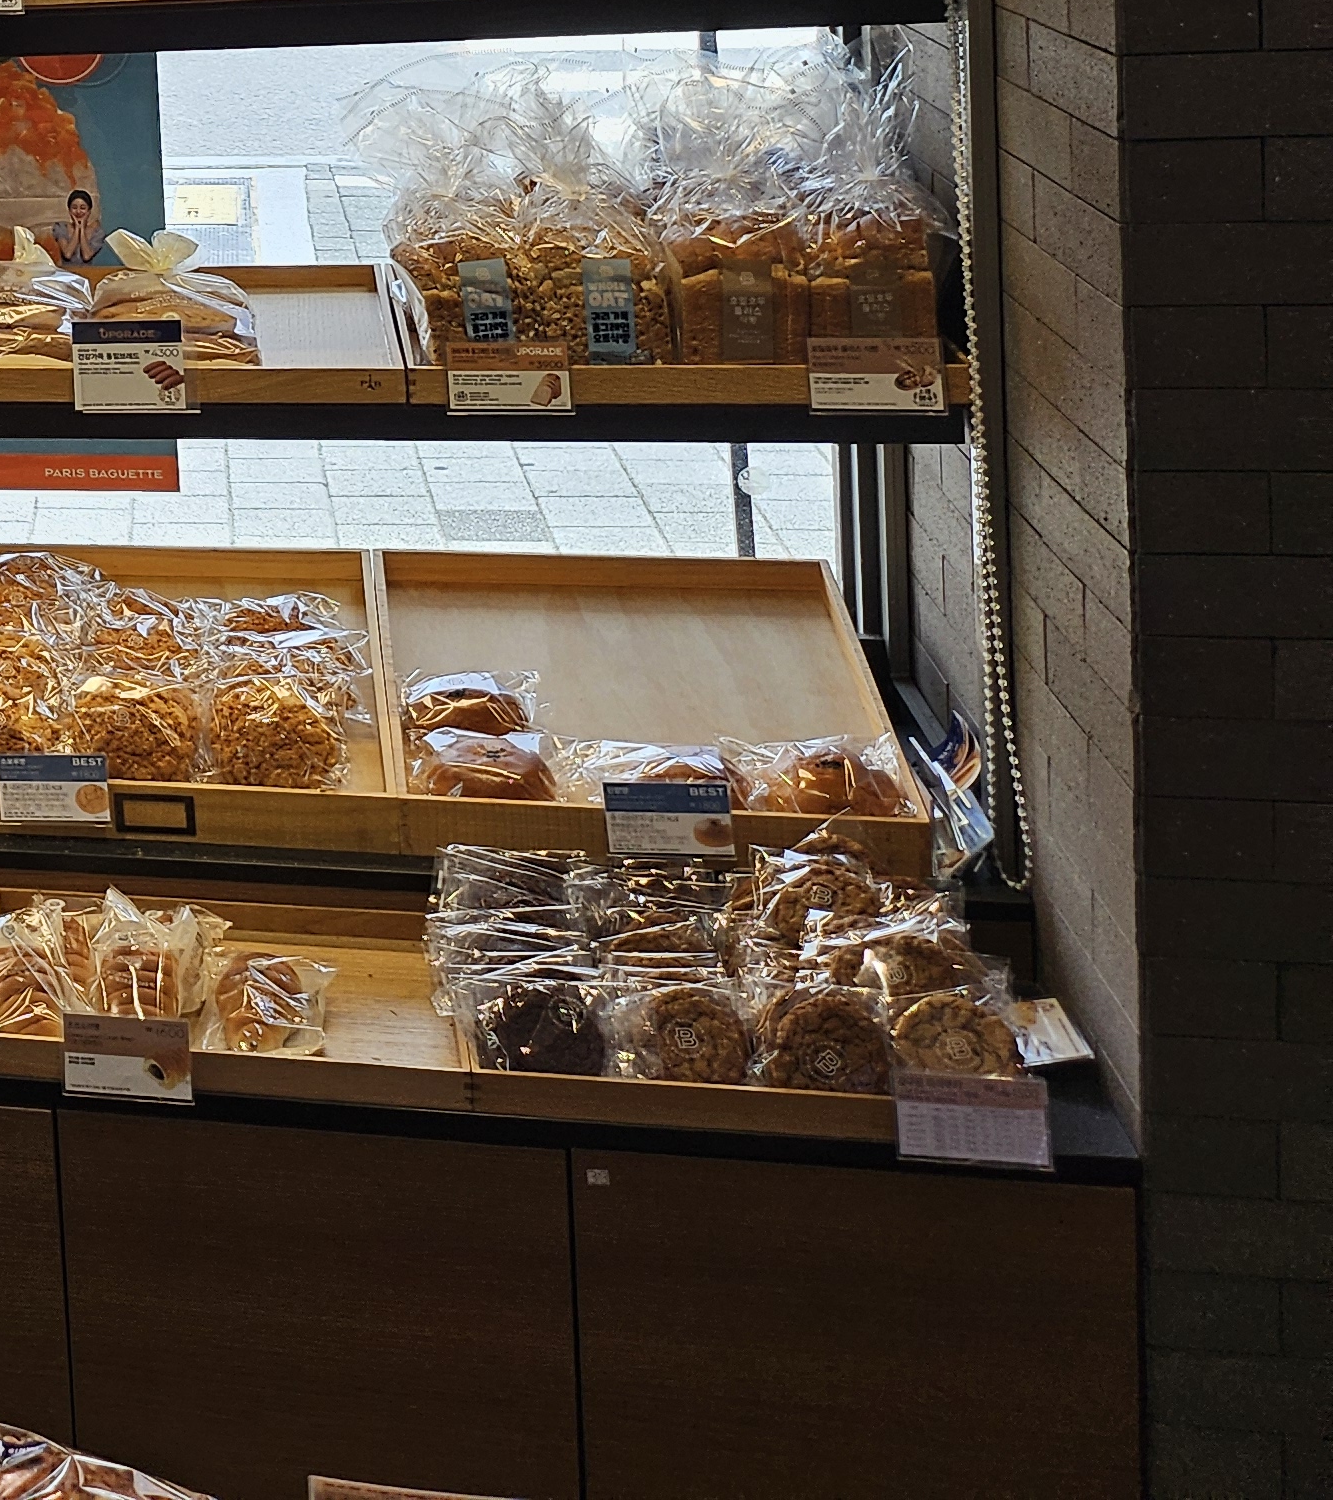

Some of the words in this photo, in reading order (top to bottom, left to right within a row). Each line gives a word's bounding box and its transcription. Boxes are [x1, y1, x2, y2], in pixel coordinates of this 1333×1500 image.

[588, 291, 629, 307] OAT
[515, 347, 563, 356] UPGRADE
[44, 468, 85, 479] PARIS
[89, 468, 164, 480] BAGUETTE
[72, 756, 103, 766] BEST
[689, 787, 725, 797] BEST
